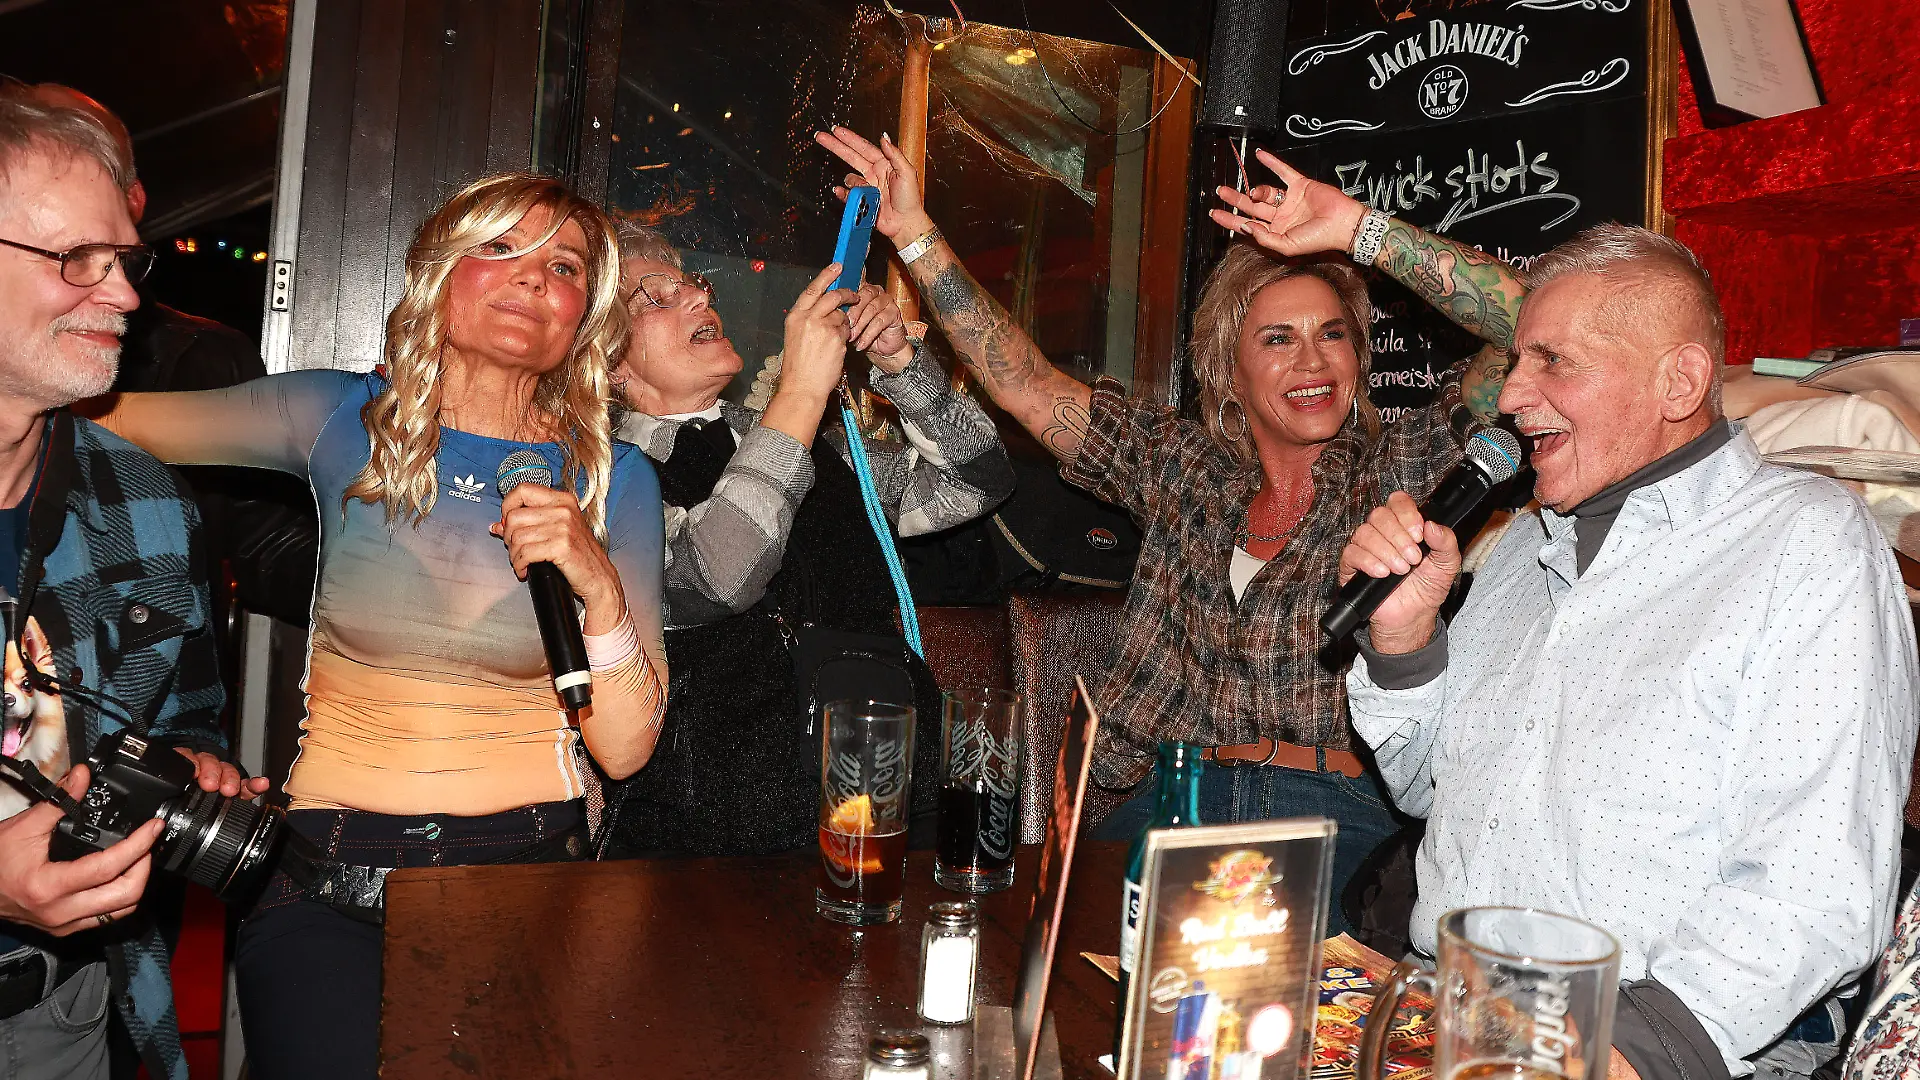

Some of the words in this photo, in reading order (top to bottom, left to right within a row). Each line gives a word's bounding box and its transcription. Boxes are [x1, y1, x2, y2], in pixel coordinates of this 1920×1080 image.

[1367, 32, 1427, 90] JACK
[1429, 19, 1530, 68] DANIEL'S
[1434, 70, 1453, 81] OLD
[1429, 104, 1457, 116] BRAND
[448, 490, 481, 503] adidas
[978, 728, 1019, 859] Coca-Cola
[1319, 977, 1373, 991] KE
